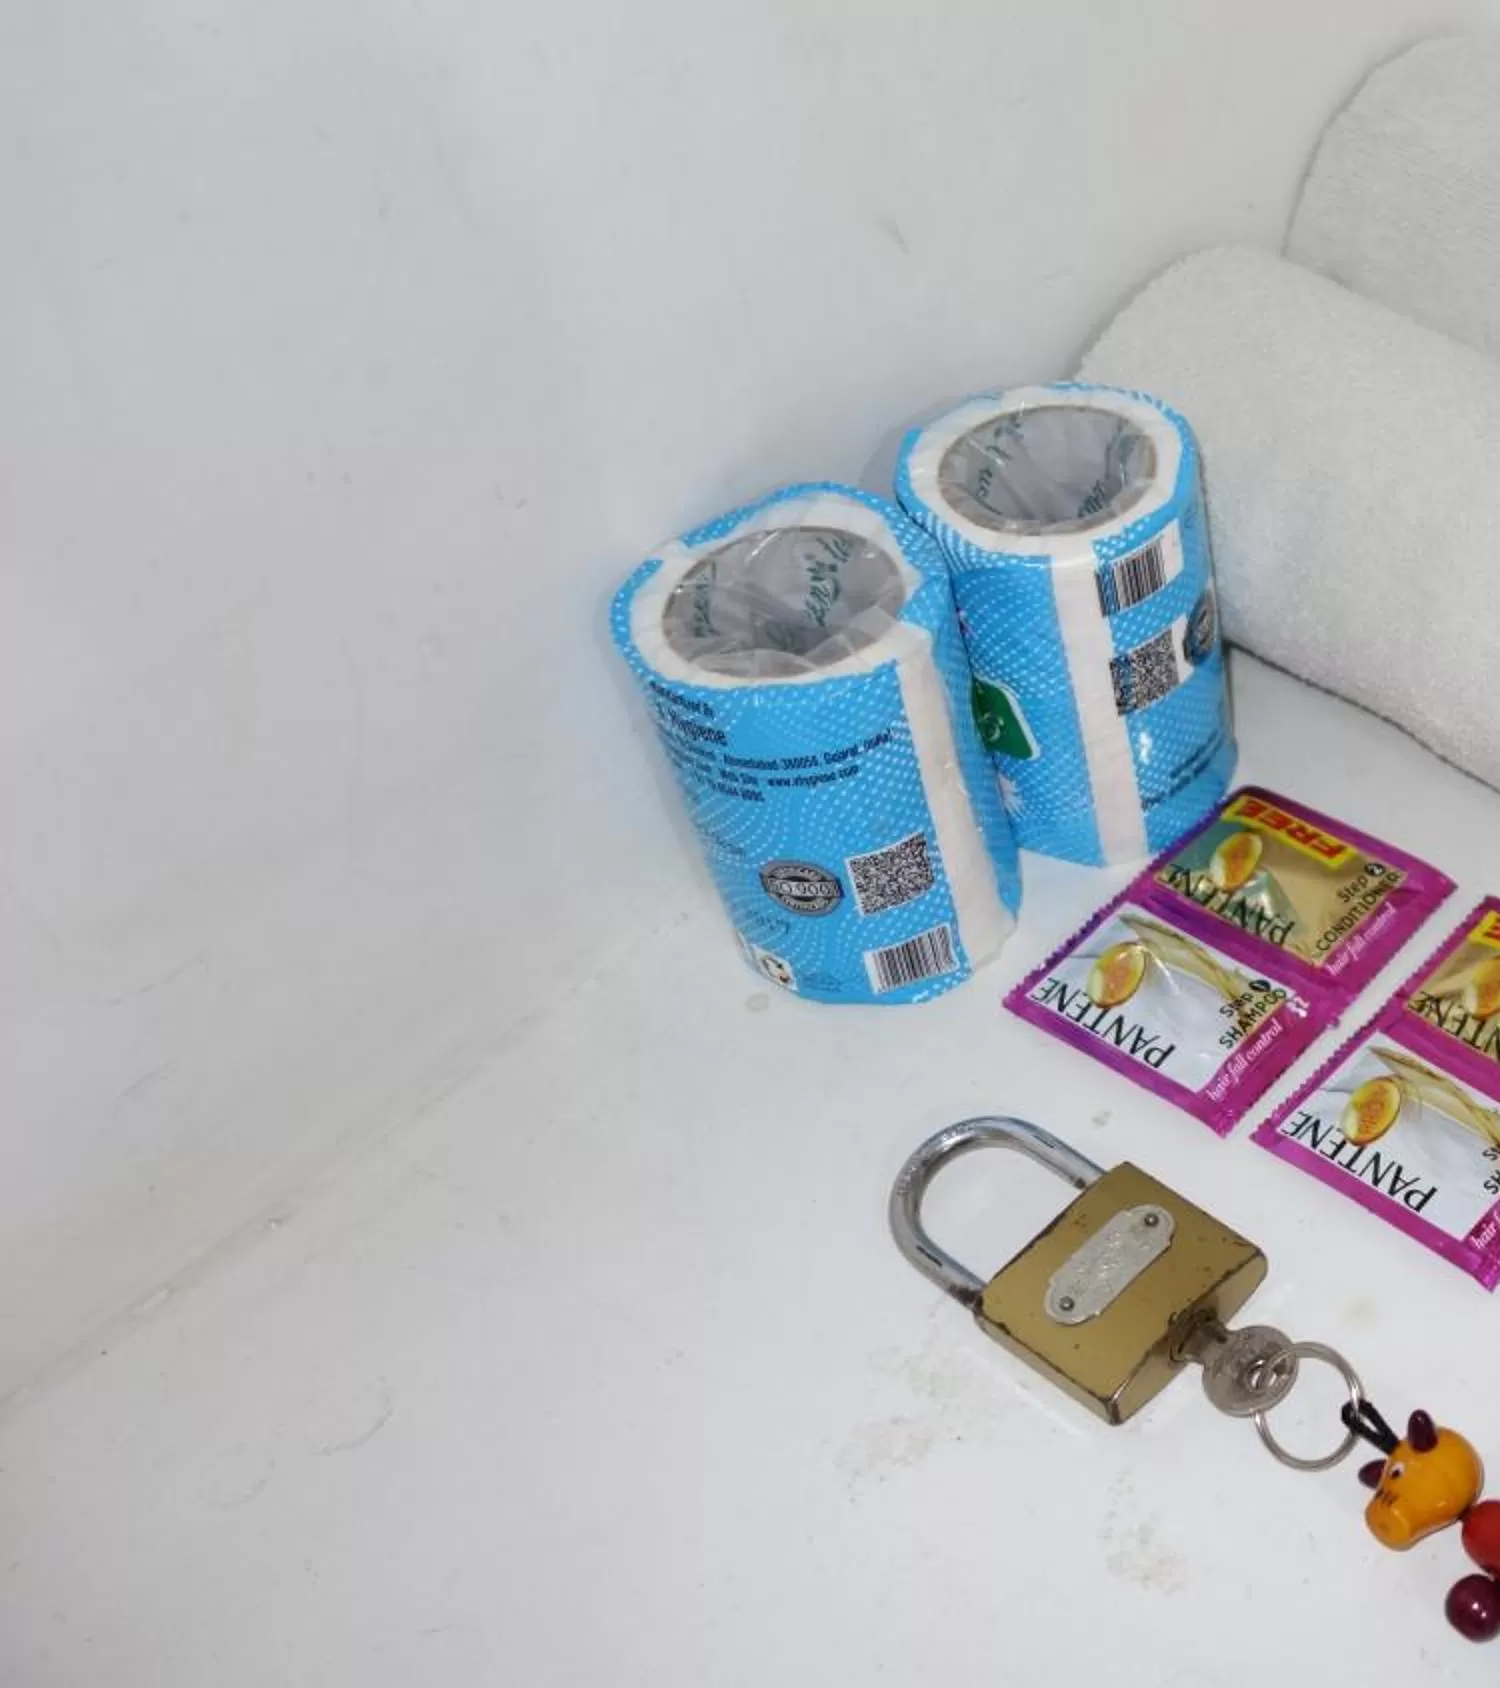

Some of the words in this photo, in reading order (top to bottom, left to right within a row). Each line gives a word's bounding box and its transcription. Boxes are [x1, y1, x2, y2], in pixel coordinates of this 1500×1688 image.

[1236, 799, 1347, 859] FREE
[1160, 863, 1295, 948] PANTENE
[1336, 874, 1369, 903] Step
[1030, 977, 1176, 1069] PANTENE
[1218, 987, 1287, 1049] SHAMPOO
[1219, 992, 1254, 1018] Step
[1205, 1074, 1231, 1101] hair
[1226, 1053, 1249, 1084] fall
[1245, 1016, 1284, 1061] control
[1281, 1111, 1438, 1213] PANTENE
[1470, 1221, 1497, 1249] hair
